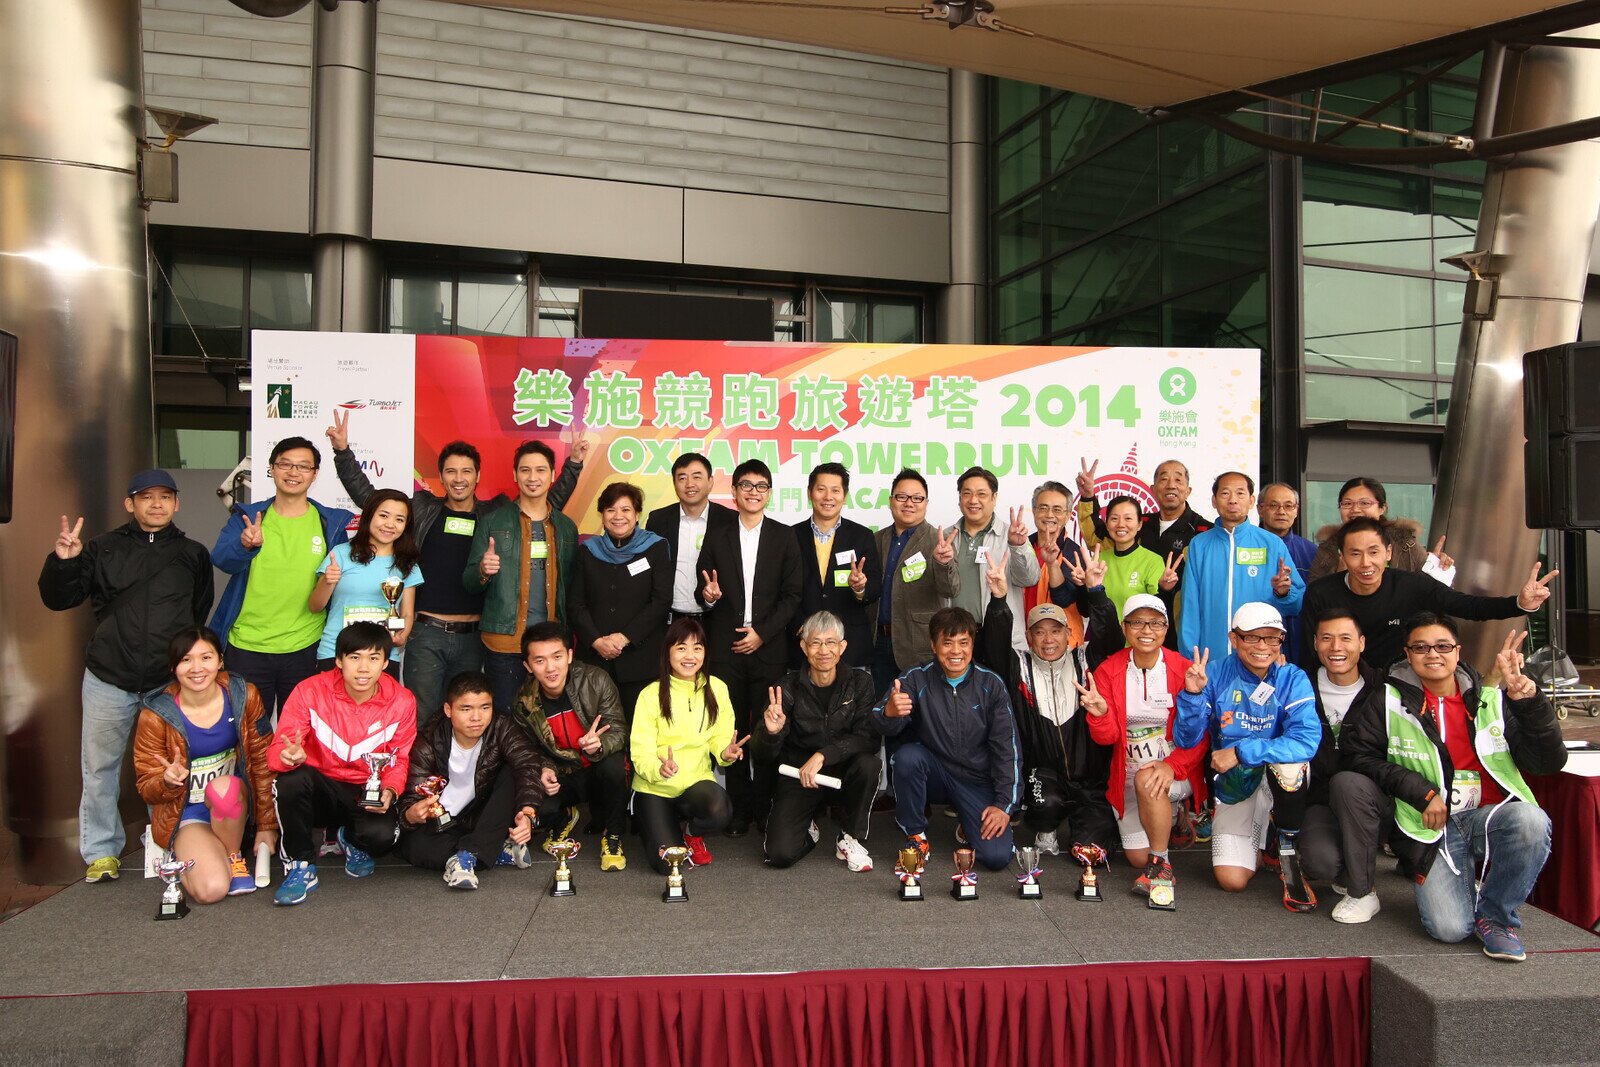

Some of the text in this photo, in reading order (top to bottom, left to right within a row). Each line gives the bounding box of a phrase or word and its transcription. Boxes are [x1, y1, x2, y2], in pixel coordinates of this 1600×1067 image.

[512, 369, 1141, 430] 樂施競跑旅遊塔 2014
[1159, 409, 1198, 423] 樂施會
[1157, 425, 1198, 438] OXFAM
[1160, 440, 1197, 449] Hong Kong
